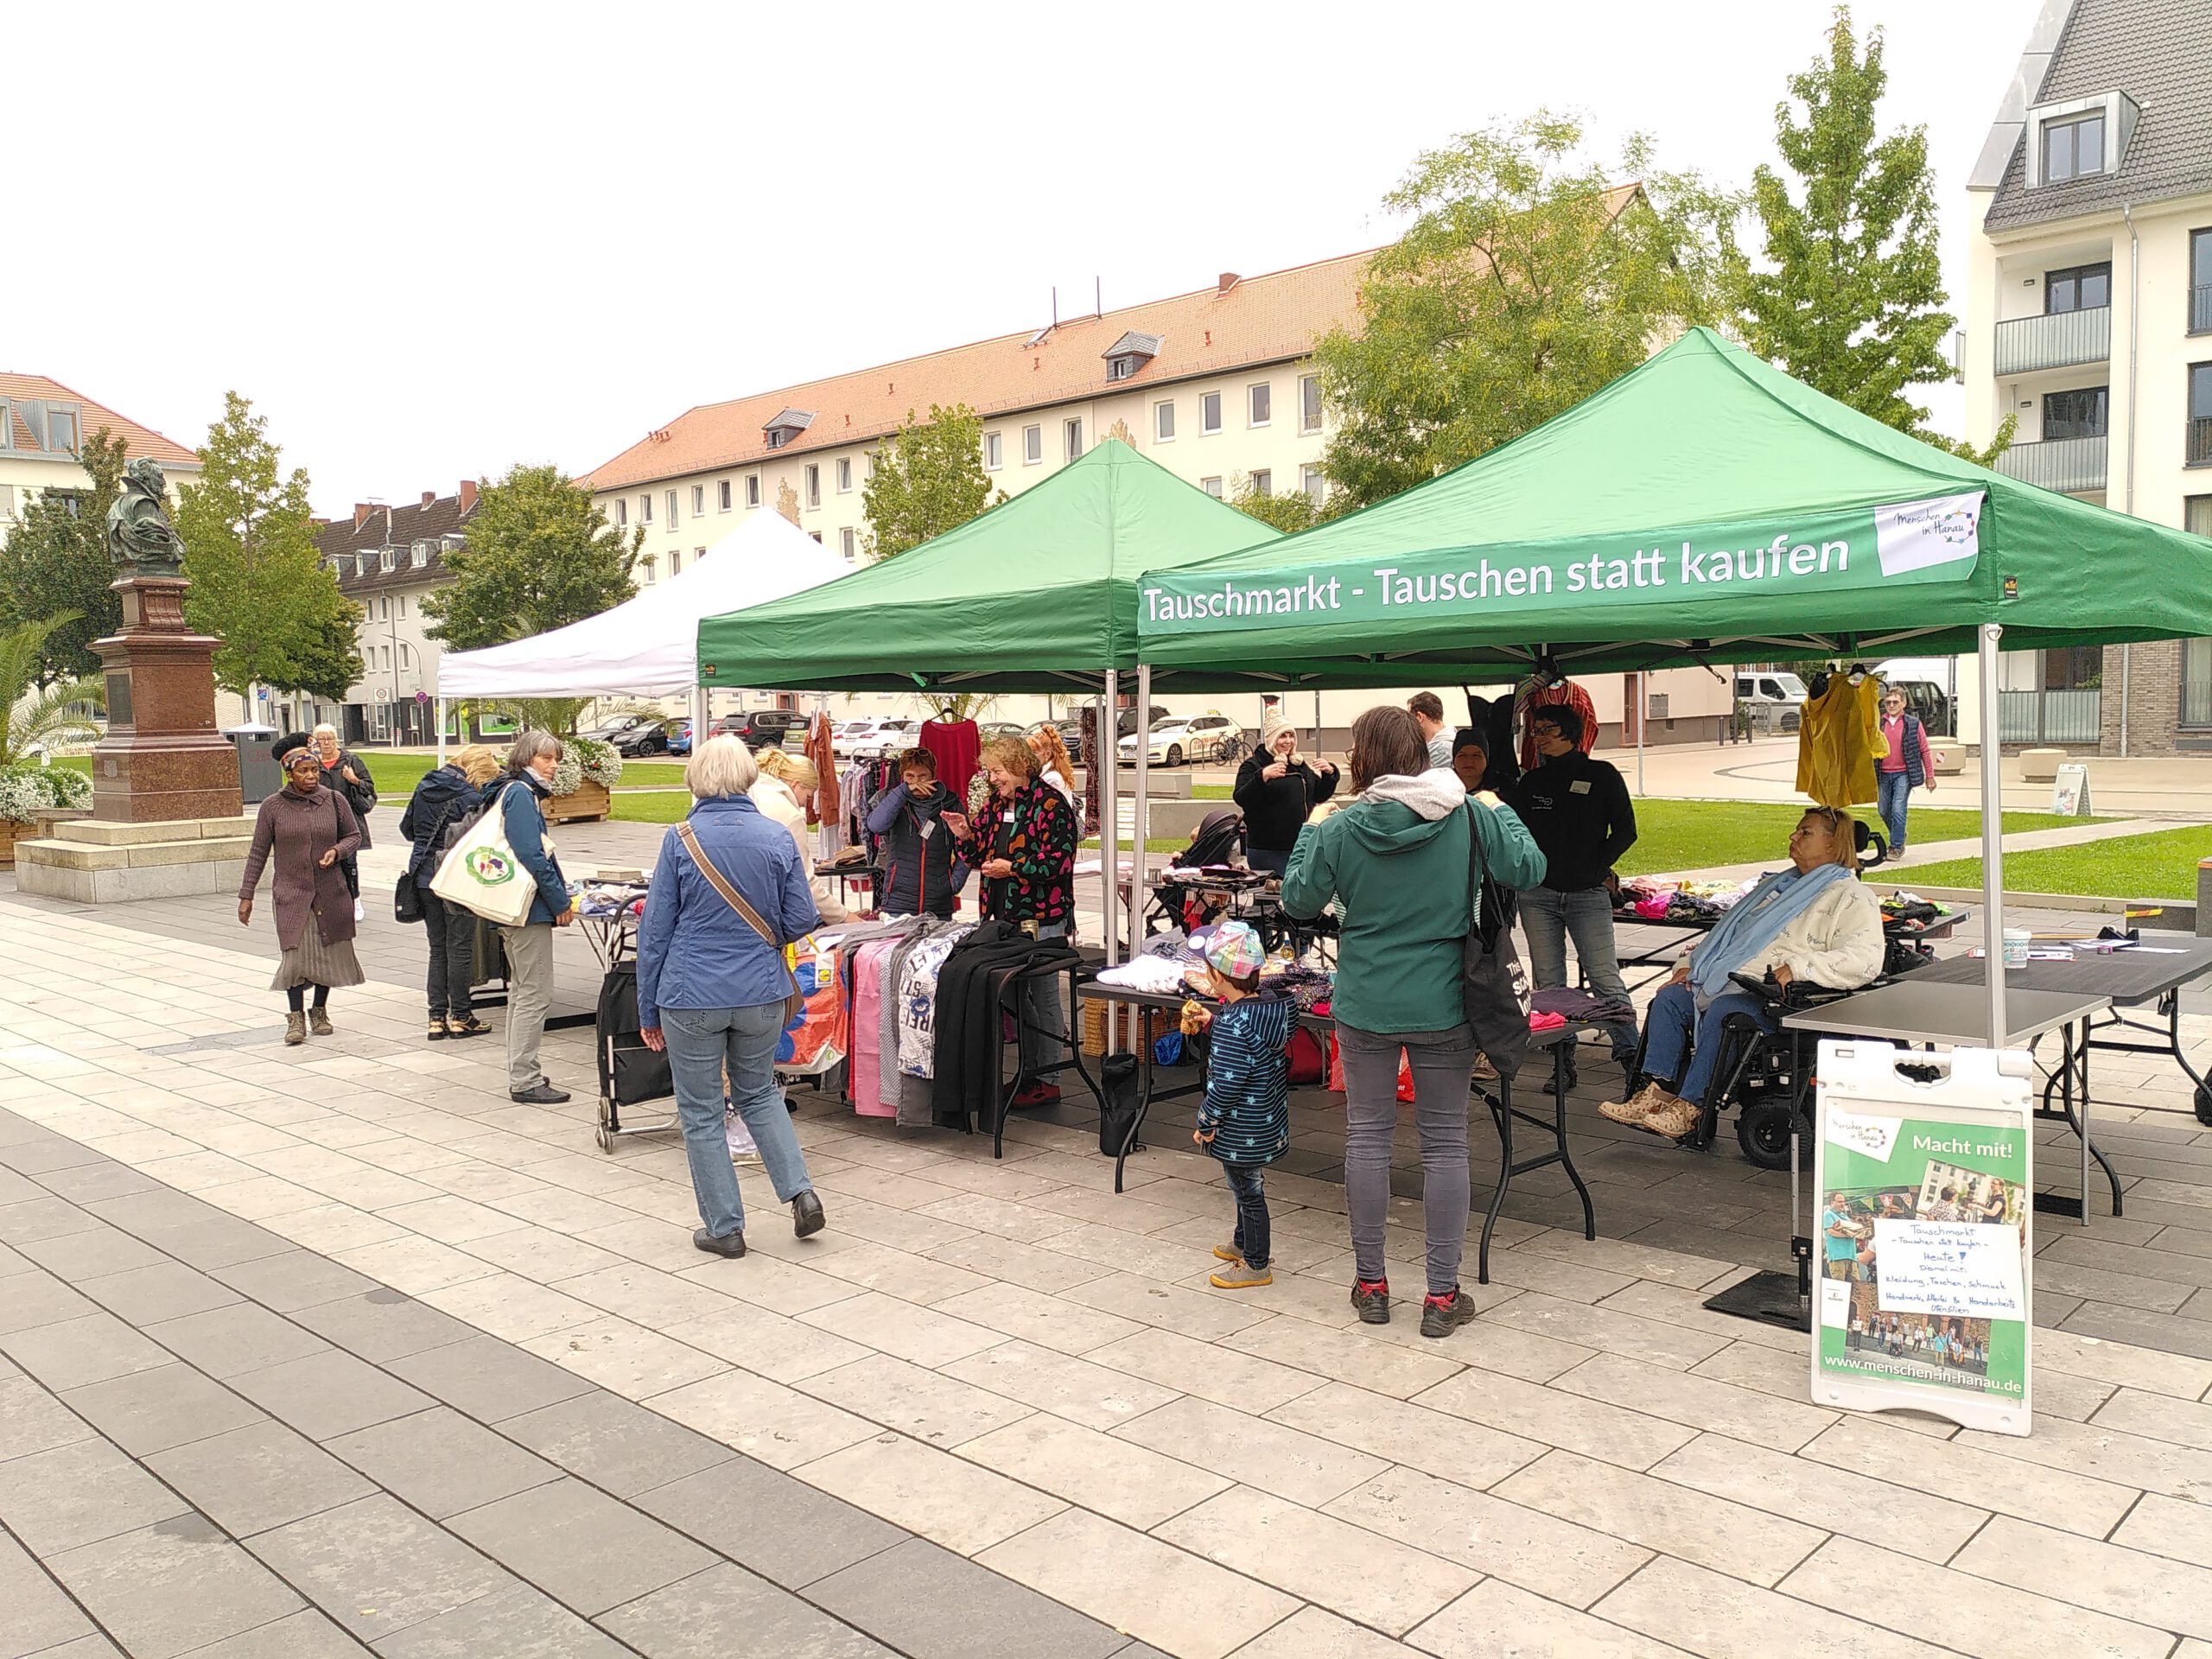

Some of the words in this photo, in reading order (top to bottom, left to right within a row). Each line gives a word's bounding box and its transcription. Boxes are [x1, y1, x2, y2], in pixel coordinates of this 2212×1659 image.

[1894, 509, 1940, 525] Menschen
[1922, 525, 1931, 536] in
[1933, 521, 1965, 535] Hanau
[1144, 575, 1341, 621] Tauschmarkt
[1374, 559, 1553, 605] Tauschen
[1567, 549, 1666, 592] statt
[1681, 534, 1849, 584] kaufen
[1913, 1135, 1971, 1155] Macht
[1976, 1140, 2012, 1159] mit!
[1910, 1224, 1976, 1236] Tauschmarkt
[1923, 1251, 1955, 1262] Heute
[1825, 1355, 2022, 1393] www.menschen-in-hanau.de
